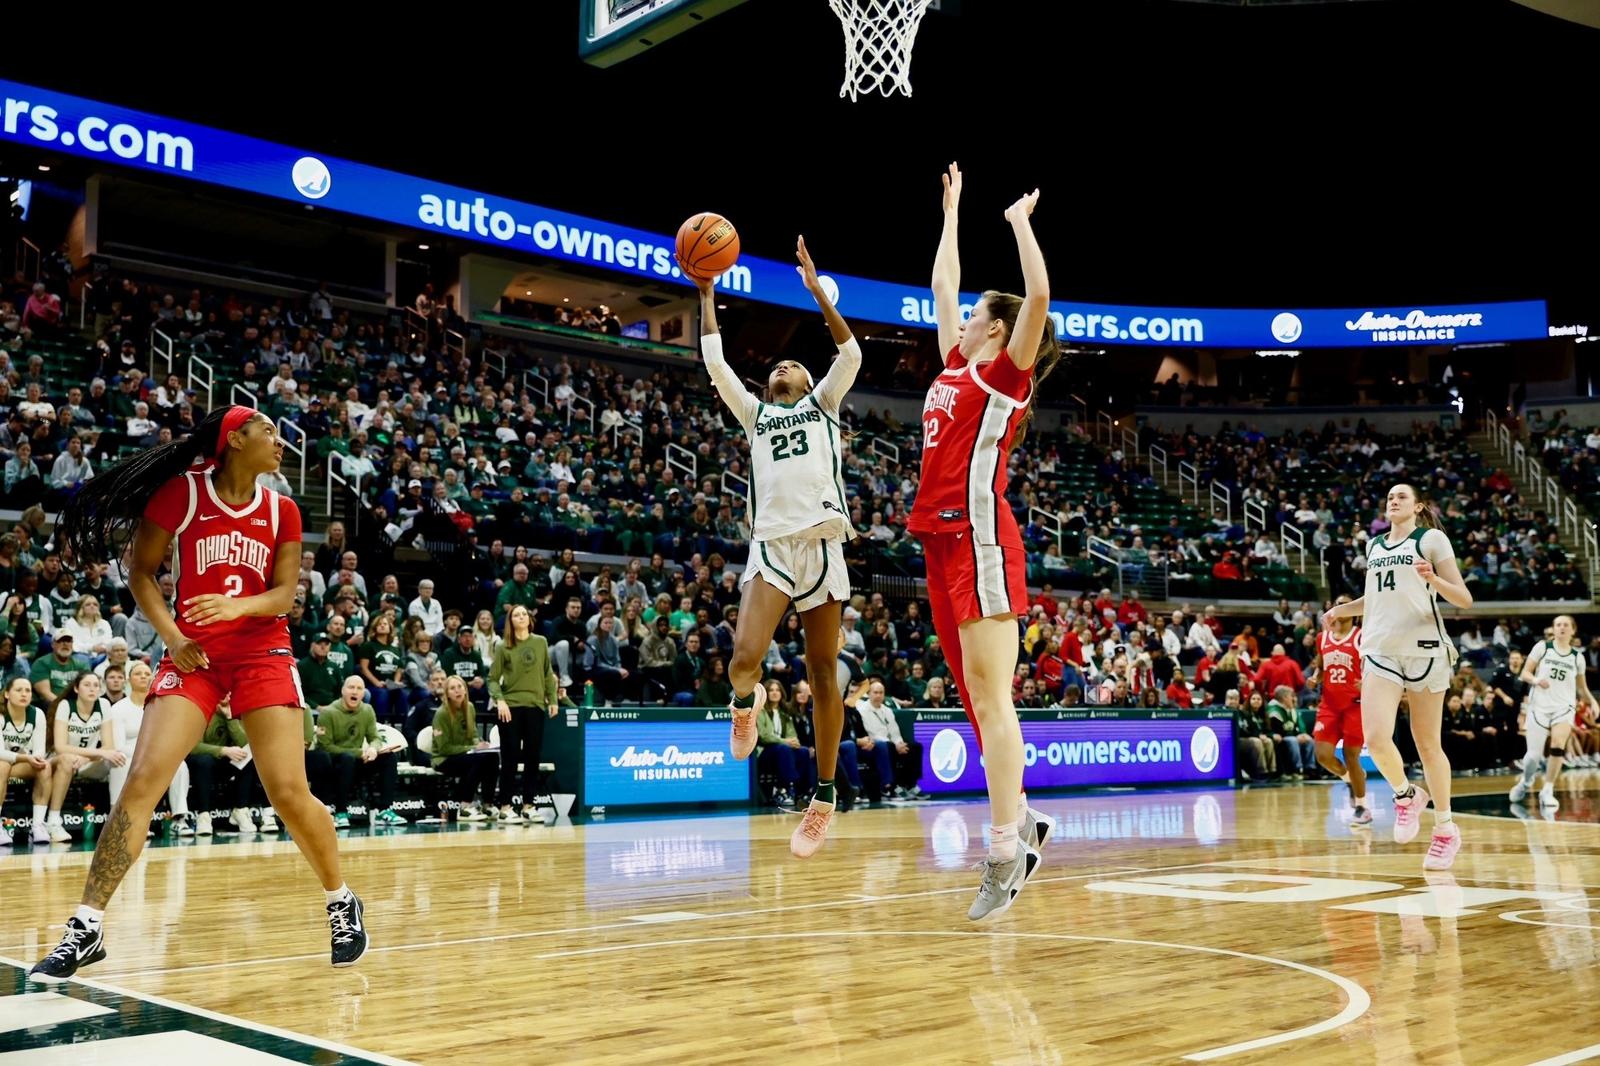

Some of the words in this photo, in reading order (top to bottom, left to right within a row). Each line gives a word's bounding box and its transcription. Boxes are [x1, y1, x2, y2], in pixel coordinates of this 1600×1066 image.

[0, 97, 194, 172] rs.com
[418, 194, 751, 293] auto-owners.m
[706, 222, 733, 245] ELITE
[901, 296, 1203, 342] auoners.com
[1345, 309, 1483, 331] Auto-Owners
[1372, 328, 1456, 342] INSURANCE
[756, 411, 821, 436] SPARTANS
[923, 418, 939, 449] 12
[770, 429, 809, 461] 23
[224, 575, 243, 598] 2
[1376, 570, 1396, 592] 14
[1330, 668, 1347, 684] 22
[1550, 668, 1567, 681] 35
[67, 724, 101, 735] SPARTAN
[79, 736, 90, 748] 5
[980, 739, 1182, 767] o-owners.com
[610, 745, 725, 768] Auto-Owners
[633, 767, 703, 780] INSURANCE
